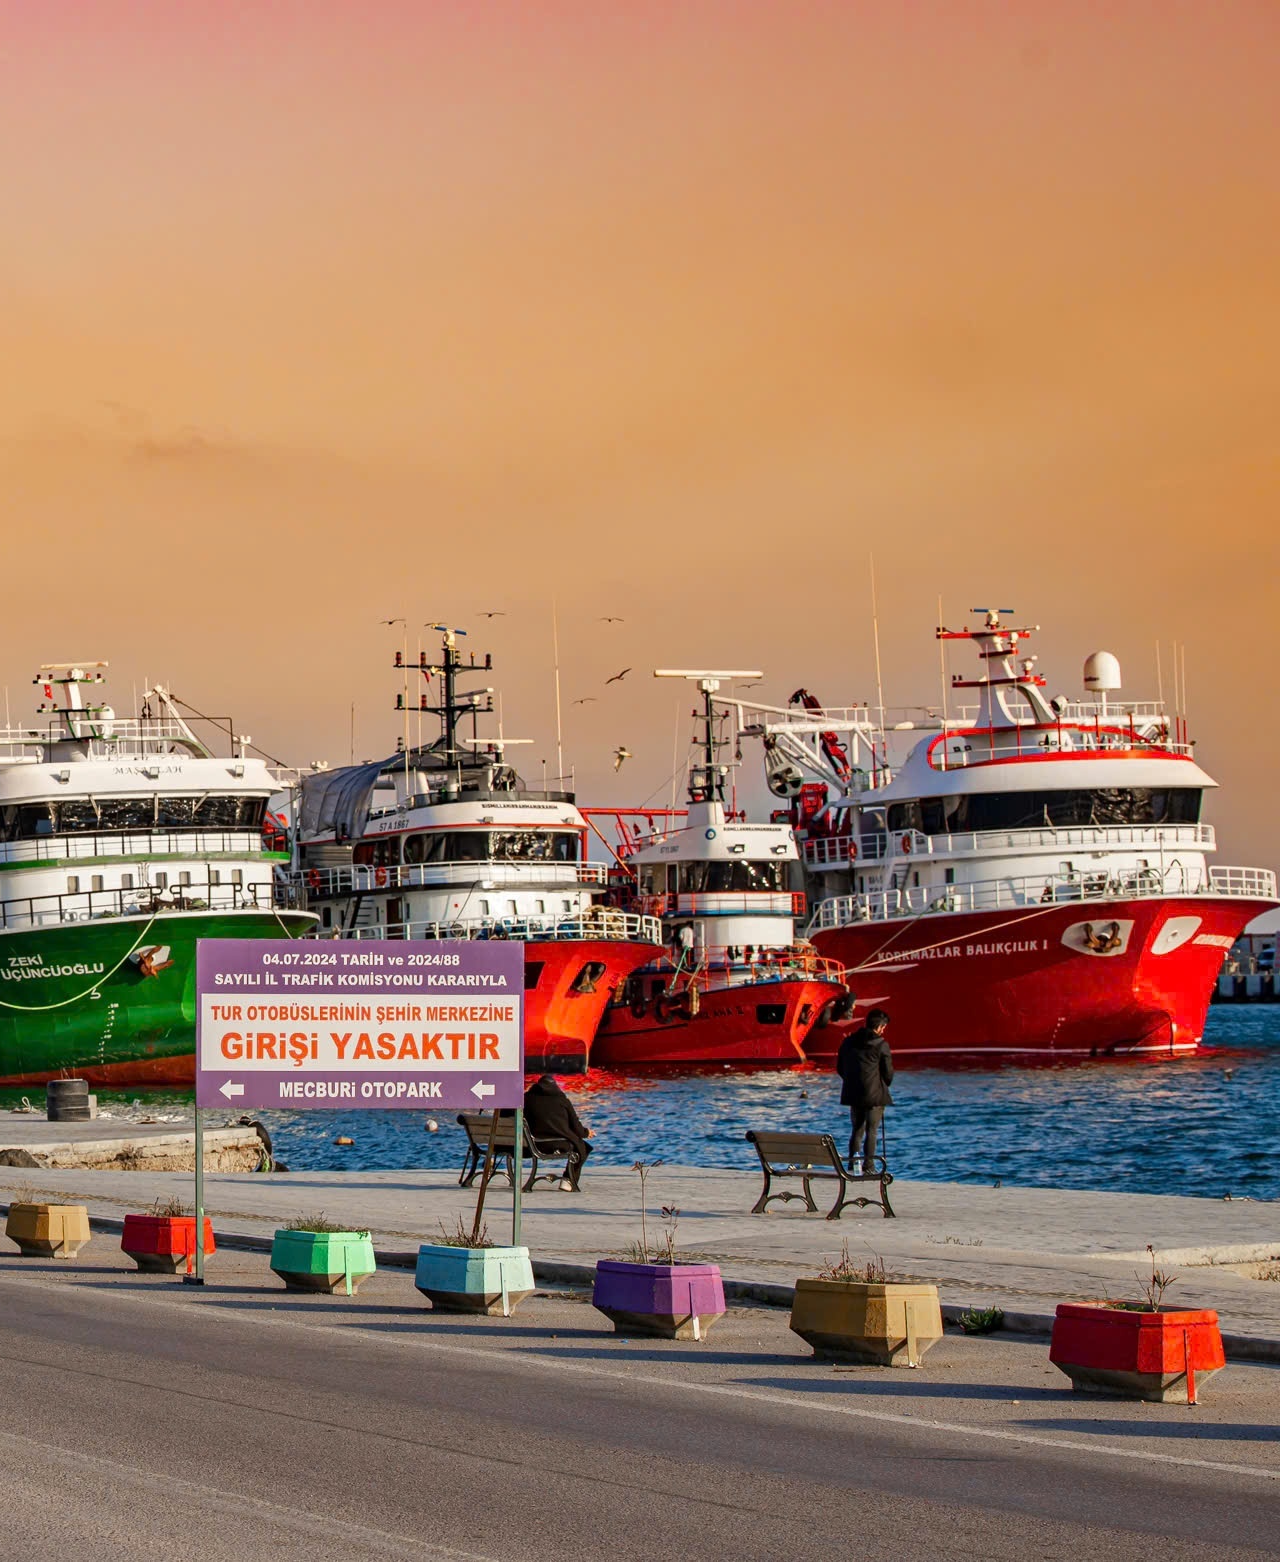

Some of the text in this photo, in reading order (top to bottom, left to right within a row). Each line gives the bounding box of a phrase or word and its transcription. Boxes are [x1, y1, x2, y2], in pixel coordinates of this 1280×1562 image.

[262, 952, 460, 966] 04.07.2024 TARİH ve 2024/88
[878, 946, 961, 962] KORKMAZLAR
[966, 940, 1038, 955] BALIKÇILIK
[8, 954, 43, 967] ZEKİ
[0, 963, 104, 981] ÜÇÜNCÜOĞLU
[214, 971, 507, 986] SAYILI İL TRAFİK KOMİSYONU KARARIYLA
[211, 1002, 513, 1025] TUR OTOBÜSLERİNİN ŞEHİR MERKEZİNE
[330, 1032, 500, 1060] YASAKTIR
[360, 1081, 442, 1098] OTOPARK
